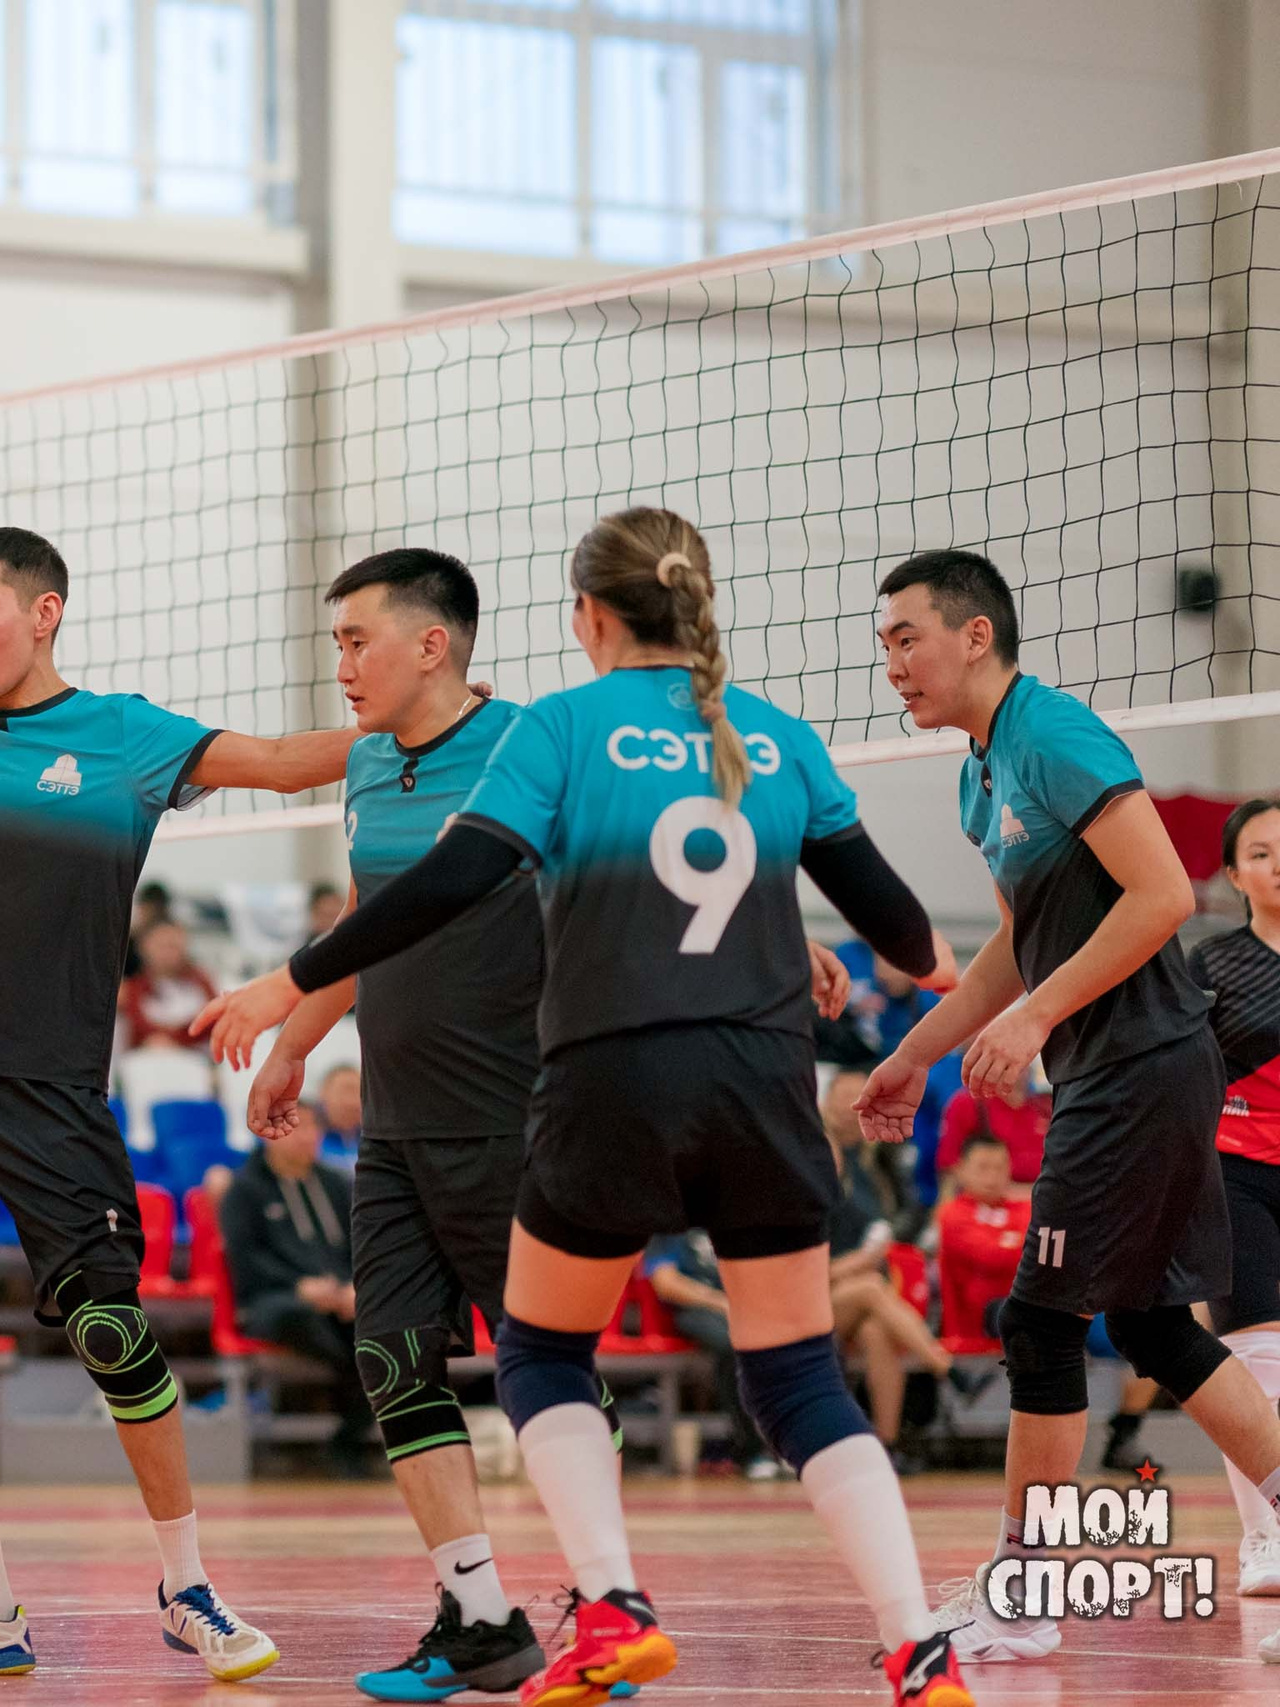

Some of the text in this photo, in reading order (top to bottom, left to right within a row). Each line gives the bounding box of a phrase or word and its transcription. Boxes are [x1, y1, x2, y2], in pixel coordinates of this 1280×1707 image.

[607, 725, 781, 775] СЭТЭ
[36, 780, 80, 796] СЭТТЭ
[1000, 831, 1030, 849] СЭТТЭ
[649, 796, 758, 954] 9
[1037, 1226, 1066, 1268] 11
